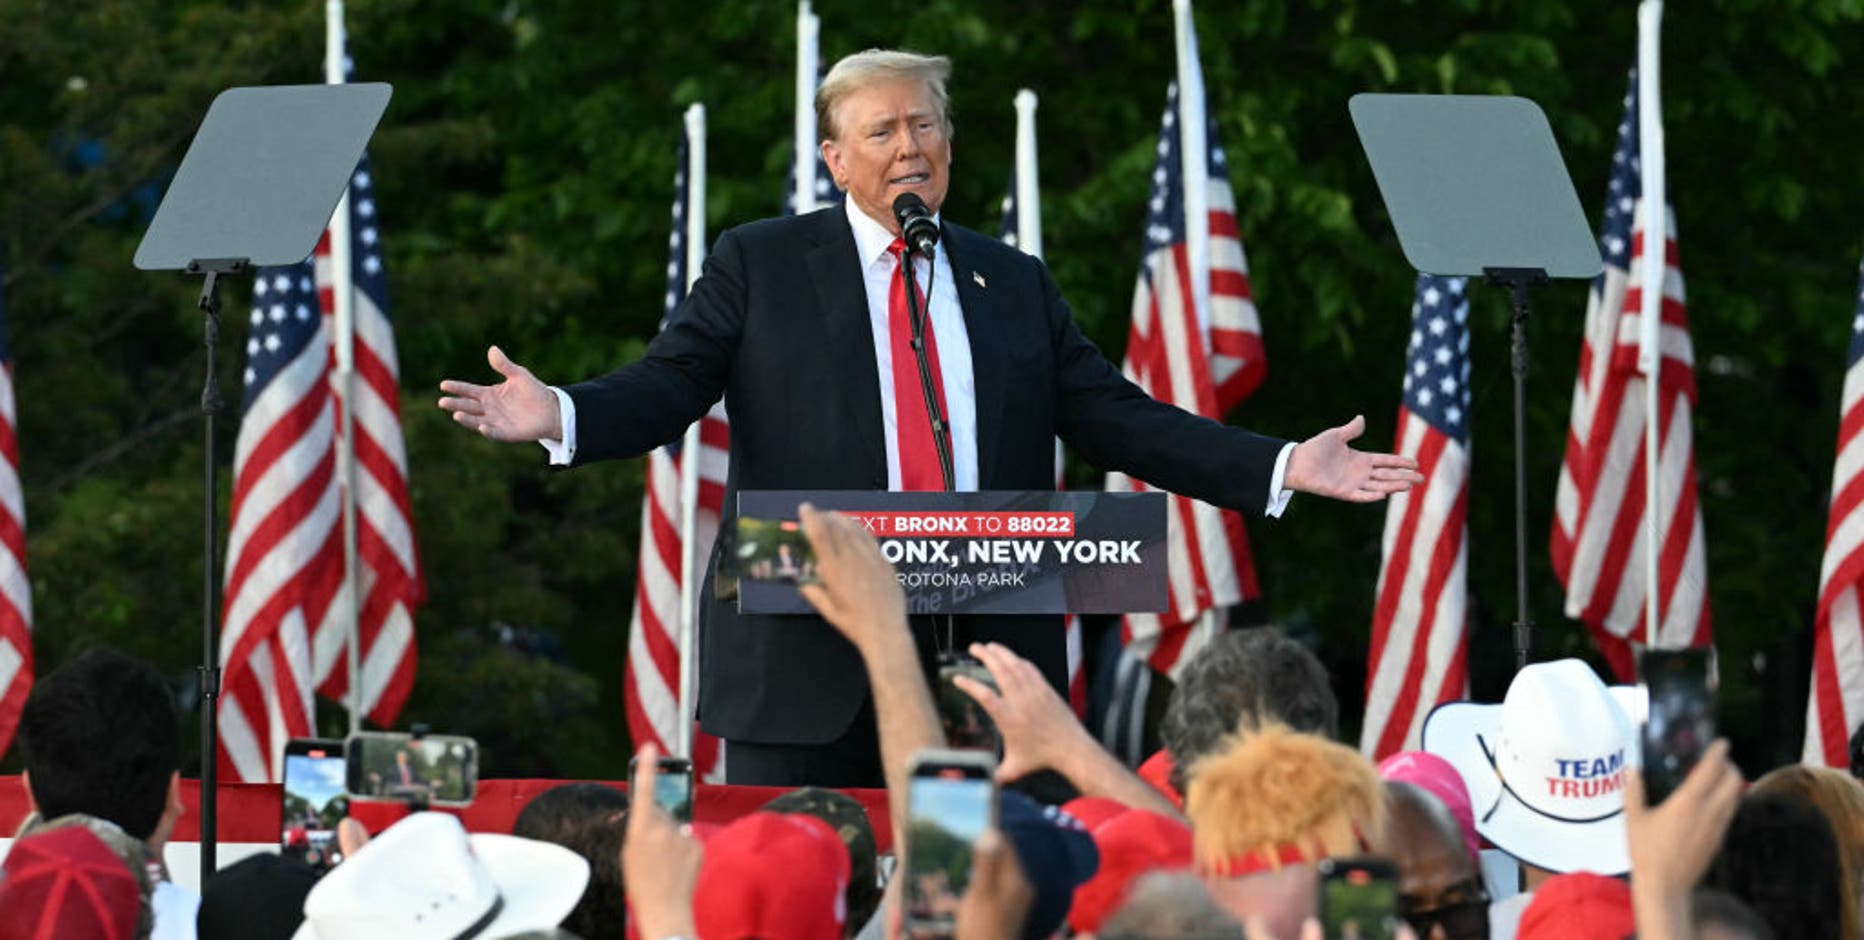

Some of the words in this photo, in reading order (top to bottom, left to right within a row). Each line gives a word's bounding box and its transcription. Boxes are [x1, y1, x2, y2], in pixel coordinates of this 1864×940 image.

[895, 516, 968, 533] BRONX
[974, 516, 1002, 533] TO
[1008, 516, 1071, 533] 88022
[881, 539, 959, 567] ONX,
[968, 540, 1044, 564] NEW
[1053, 539, 1142, 564] YORK
[896, 572, 972, 587] ROTONA
[977, 572, 1025, 587] PARK
[1554, 749, 1624, 778] TEAM
[1545, 771, 1627, 799] TRUM
